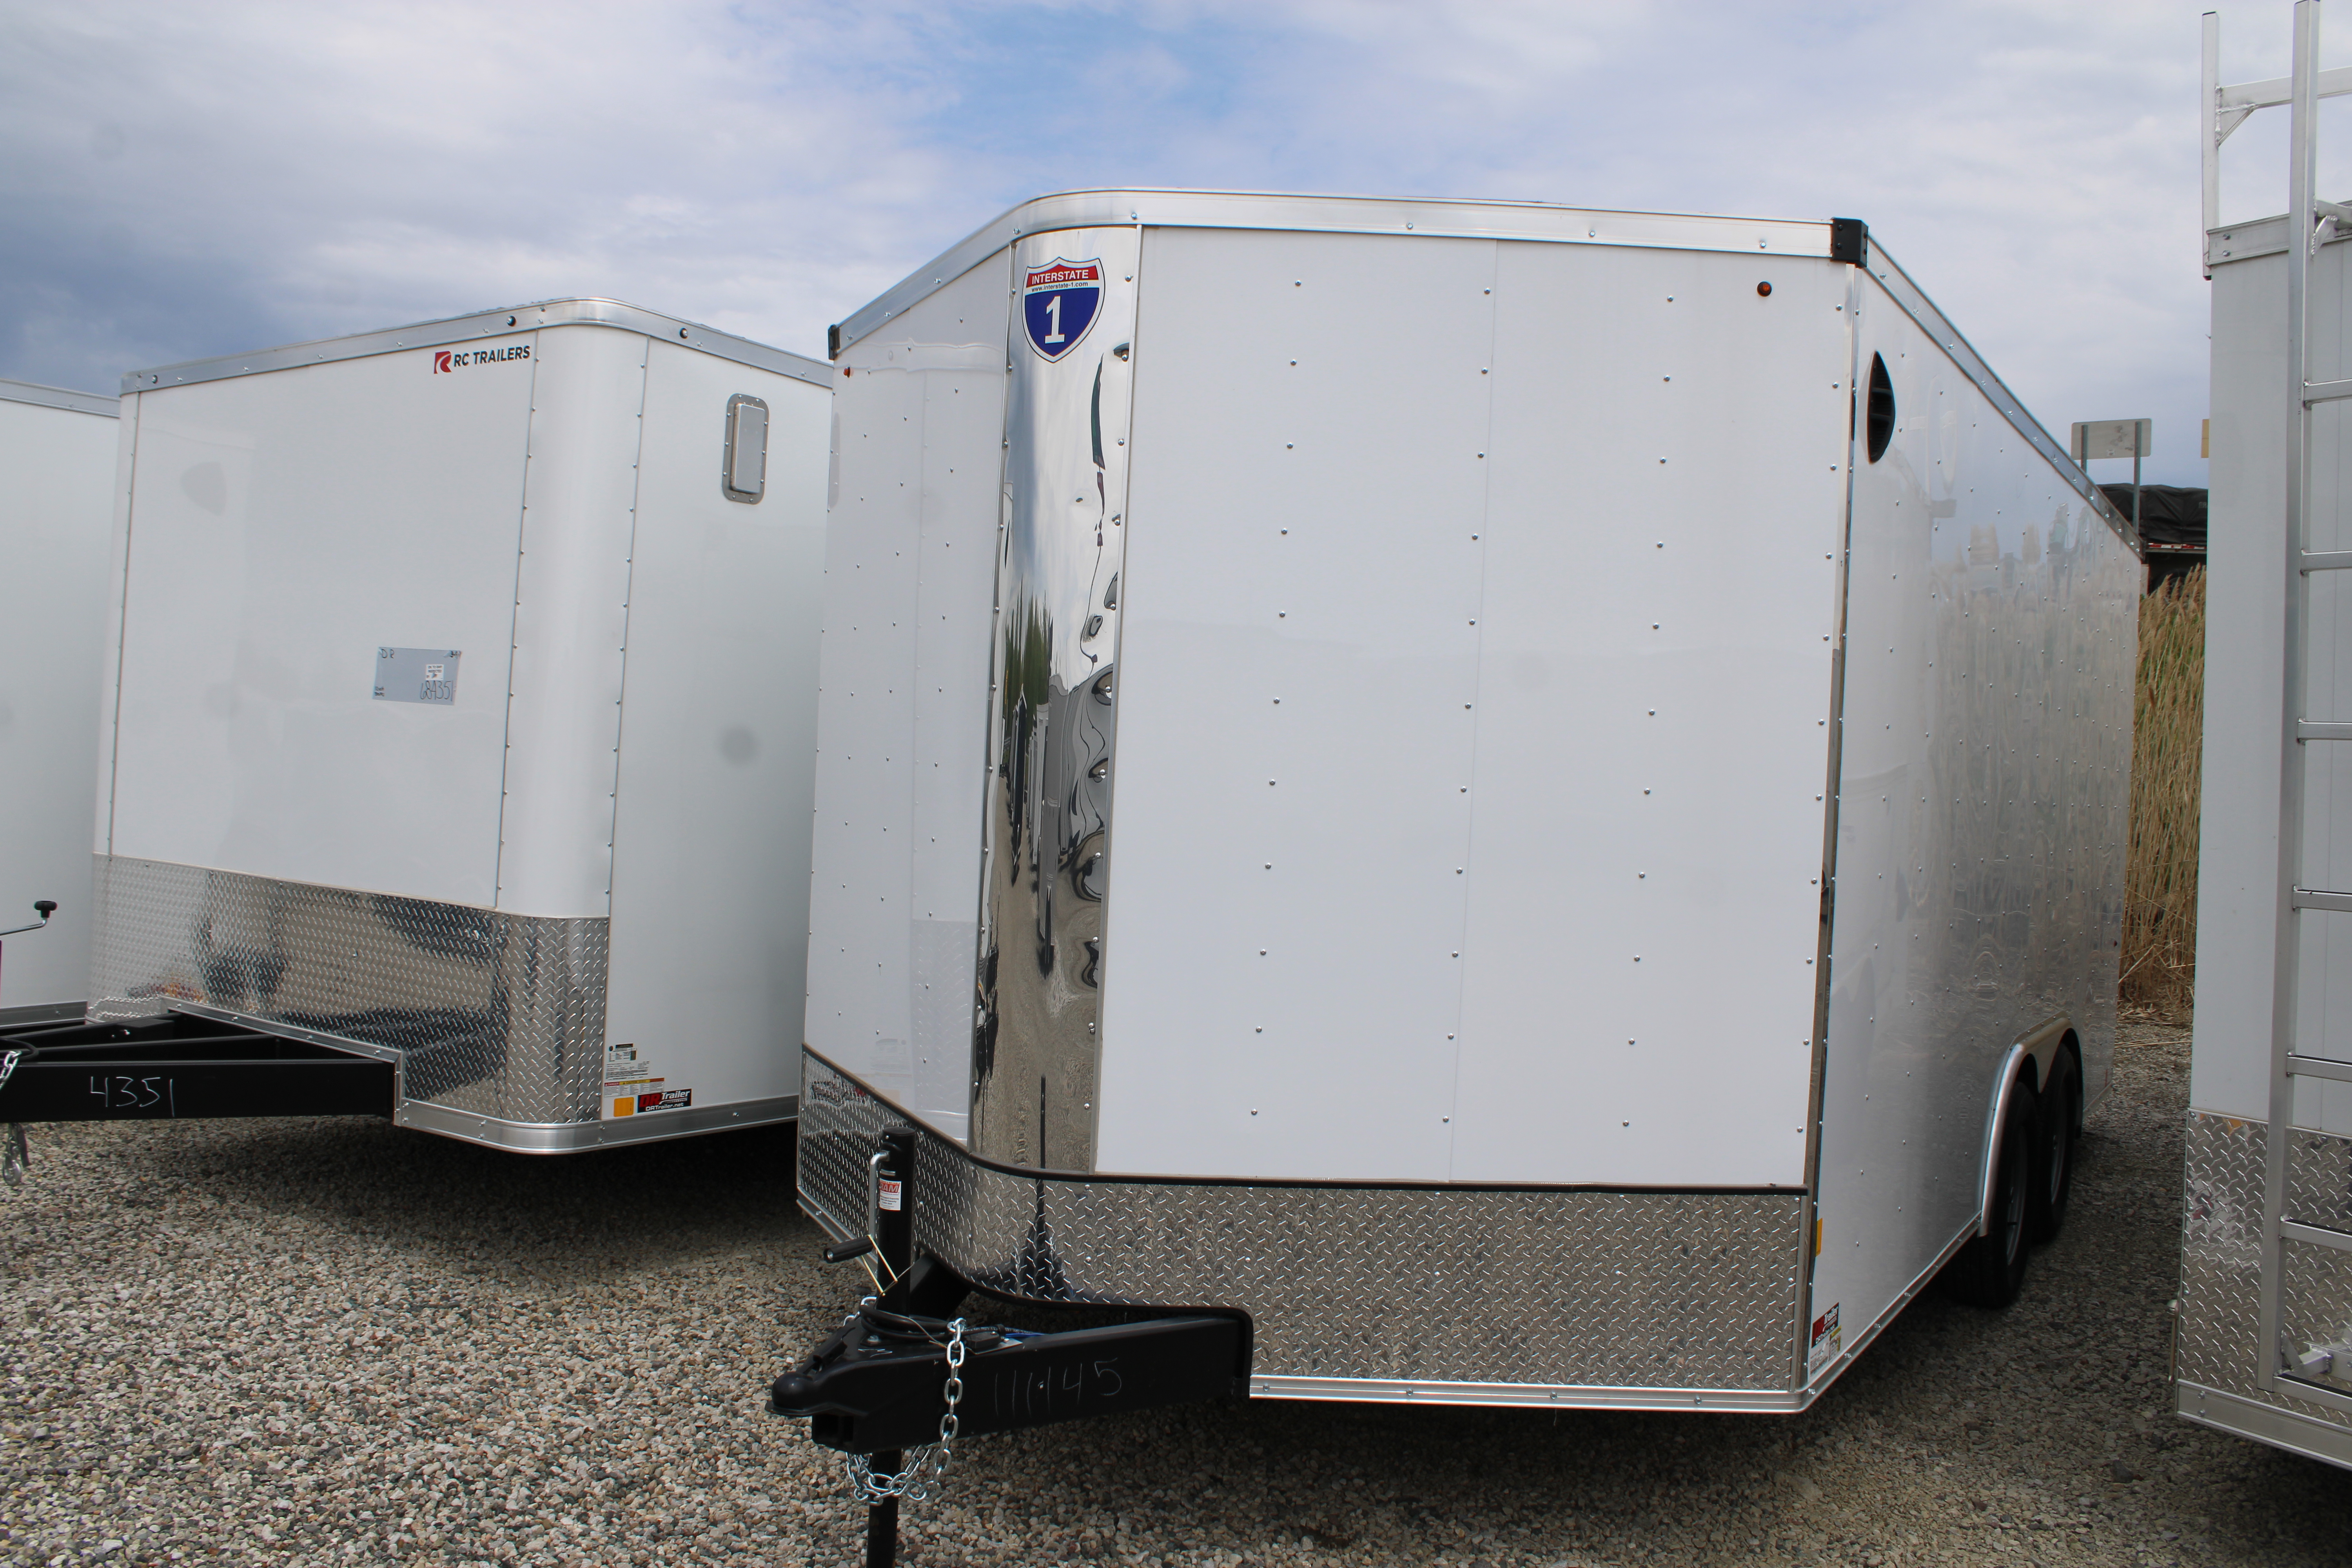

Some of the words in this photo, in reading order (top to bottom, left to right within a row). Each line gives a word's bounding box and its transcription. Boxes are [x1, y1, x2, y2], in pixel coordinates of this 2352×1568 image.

[1032, 269, 1089, 285] INTERSTATE
[1031, 281, 1088, 292] www.interstate-1.com
[1045, 295, 1065, 344] 1
[454, 352, 470, 367] RC
[473, 345, 531, 364] TRAILERS
[90, 1076, 175, 1118] 4351
[639, 1093, 661, 1108] DR
[661, 1091, 690, 1100] Trailer
[645, 1102, 684, 1111] DRTrailer.net
[880, 1183, 899, 1192] RAM
[1824, 1307, 1838, 1325] Trailer
